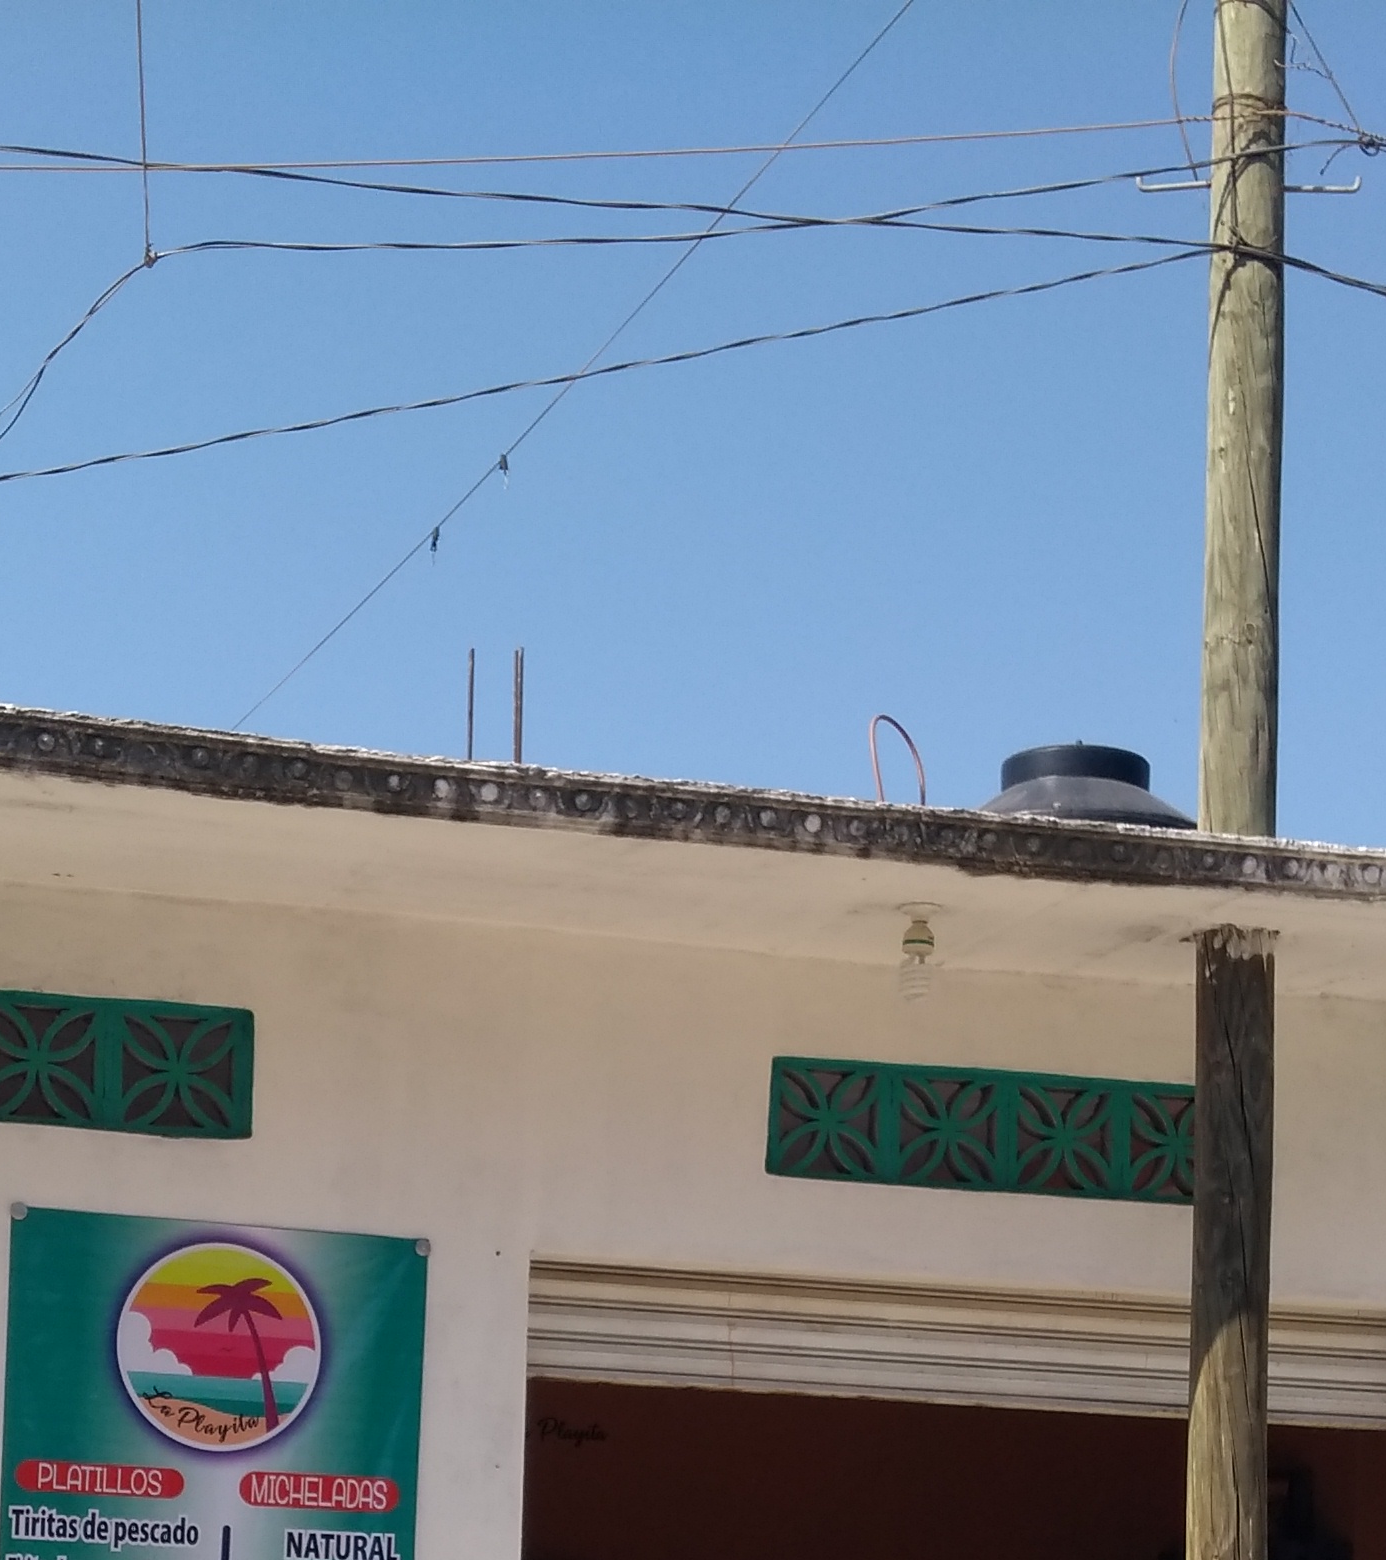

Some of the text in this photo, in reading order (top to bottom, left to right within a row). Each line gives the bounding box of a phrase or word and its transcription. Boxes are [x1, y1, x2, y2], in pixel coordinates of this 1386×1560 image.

[142, 1385, 260, 1443] La Playita
[38, 1463, 162, 1495] PLATILLOS
[250, 1474, 388, 1510] MICHELADAS
[11, 1508, 199, 1548] Tiritas de pescado
